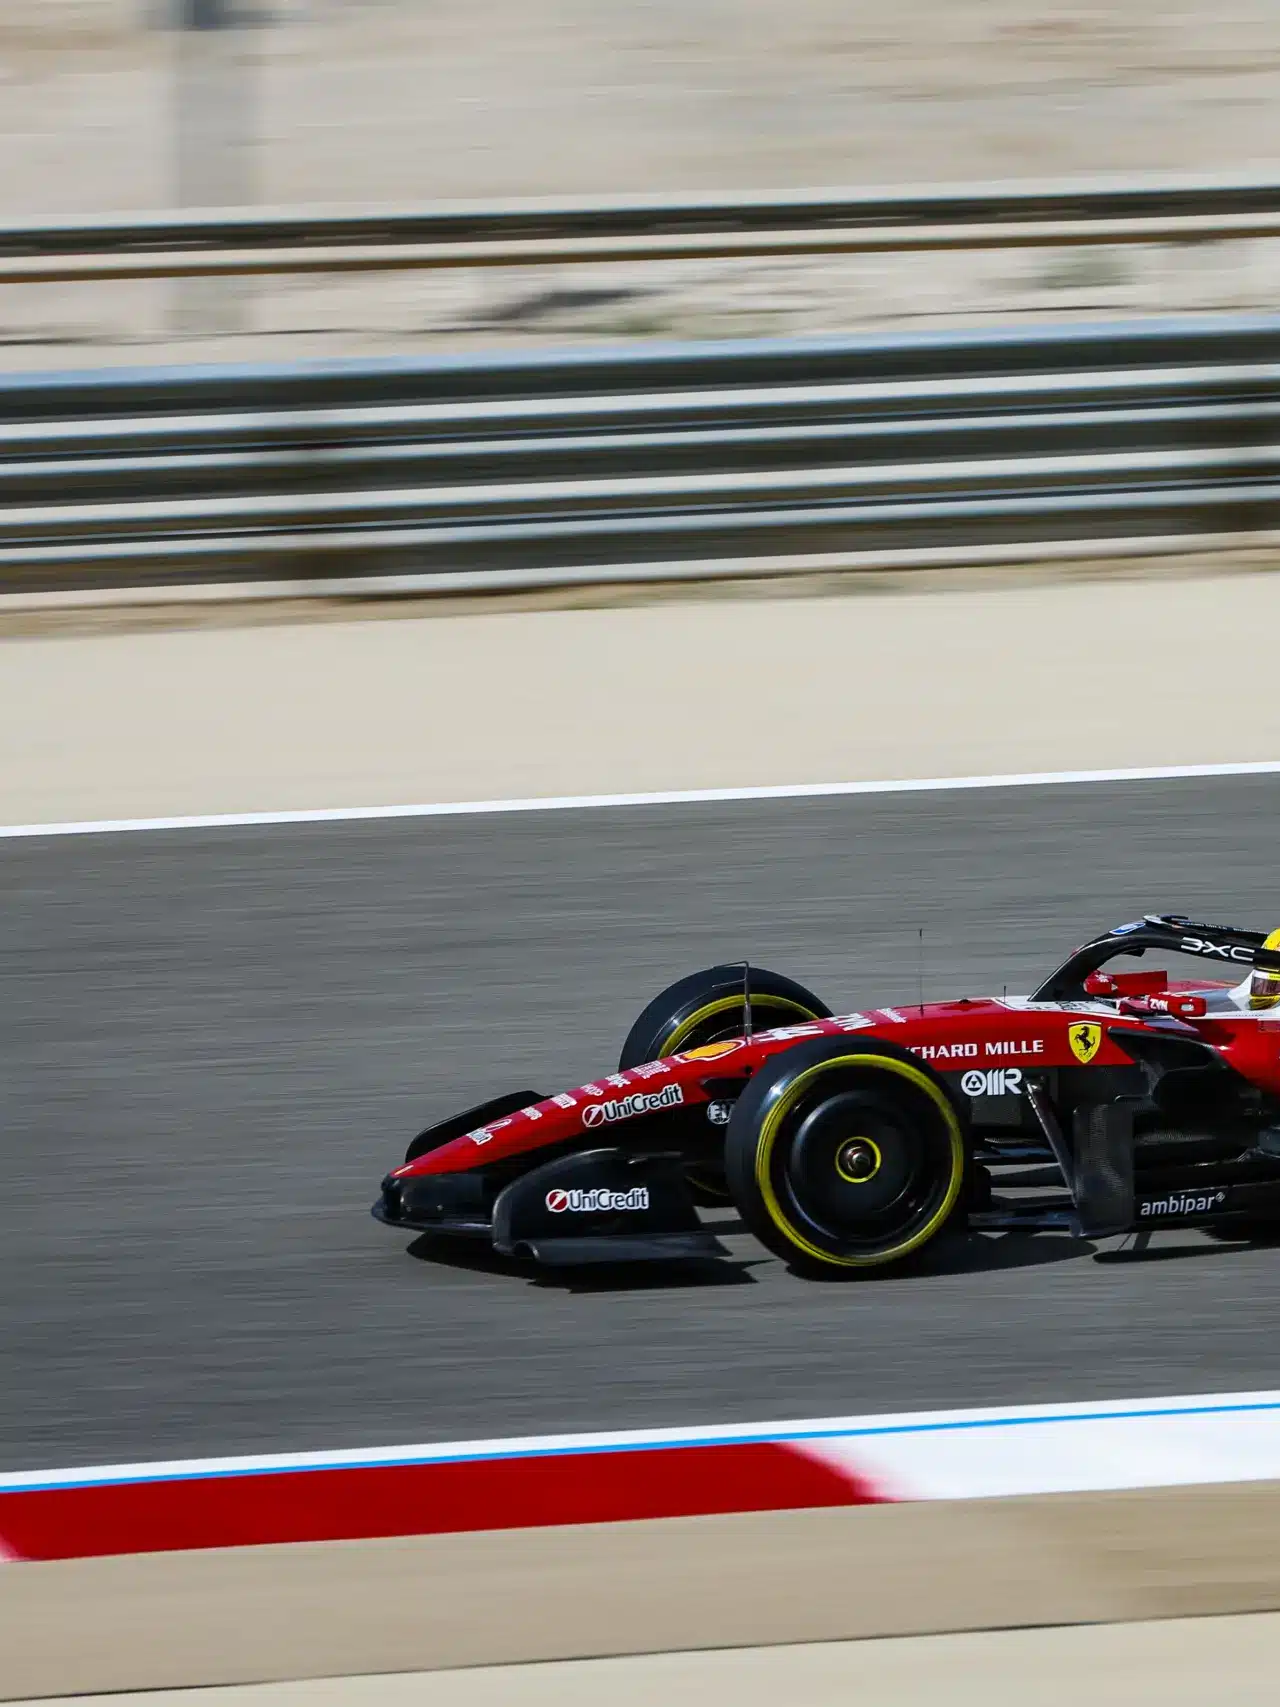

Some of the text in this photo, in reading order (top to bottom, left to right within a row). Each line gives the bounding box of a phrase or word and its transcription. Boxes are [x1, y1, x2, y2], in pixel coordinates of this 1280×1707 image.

[1150, 999, 1169, 1011] ZYN
[985, 1039, 1044, 1056] MILLE
[604, 1087, 682, 1120] UniCredit
[569, 1188, 649, 1211] UniCredit
[1140, 1195, 1216, 1216] ambipar
